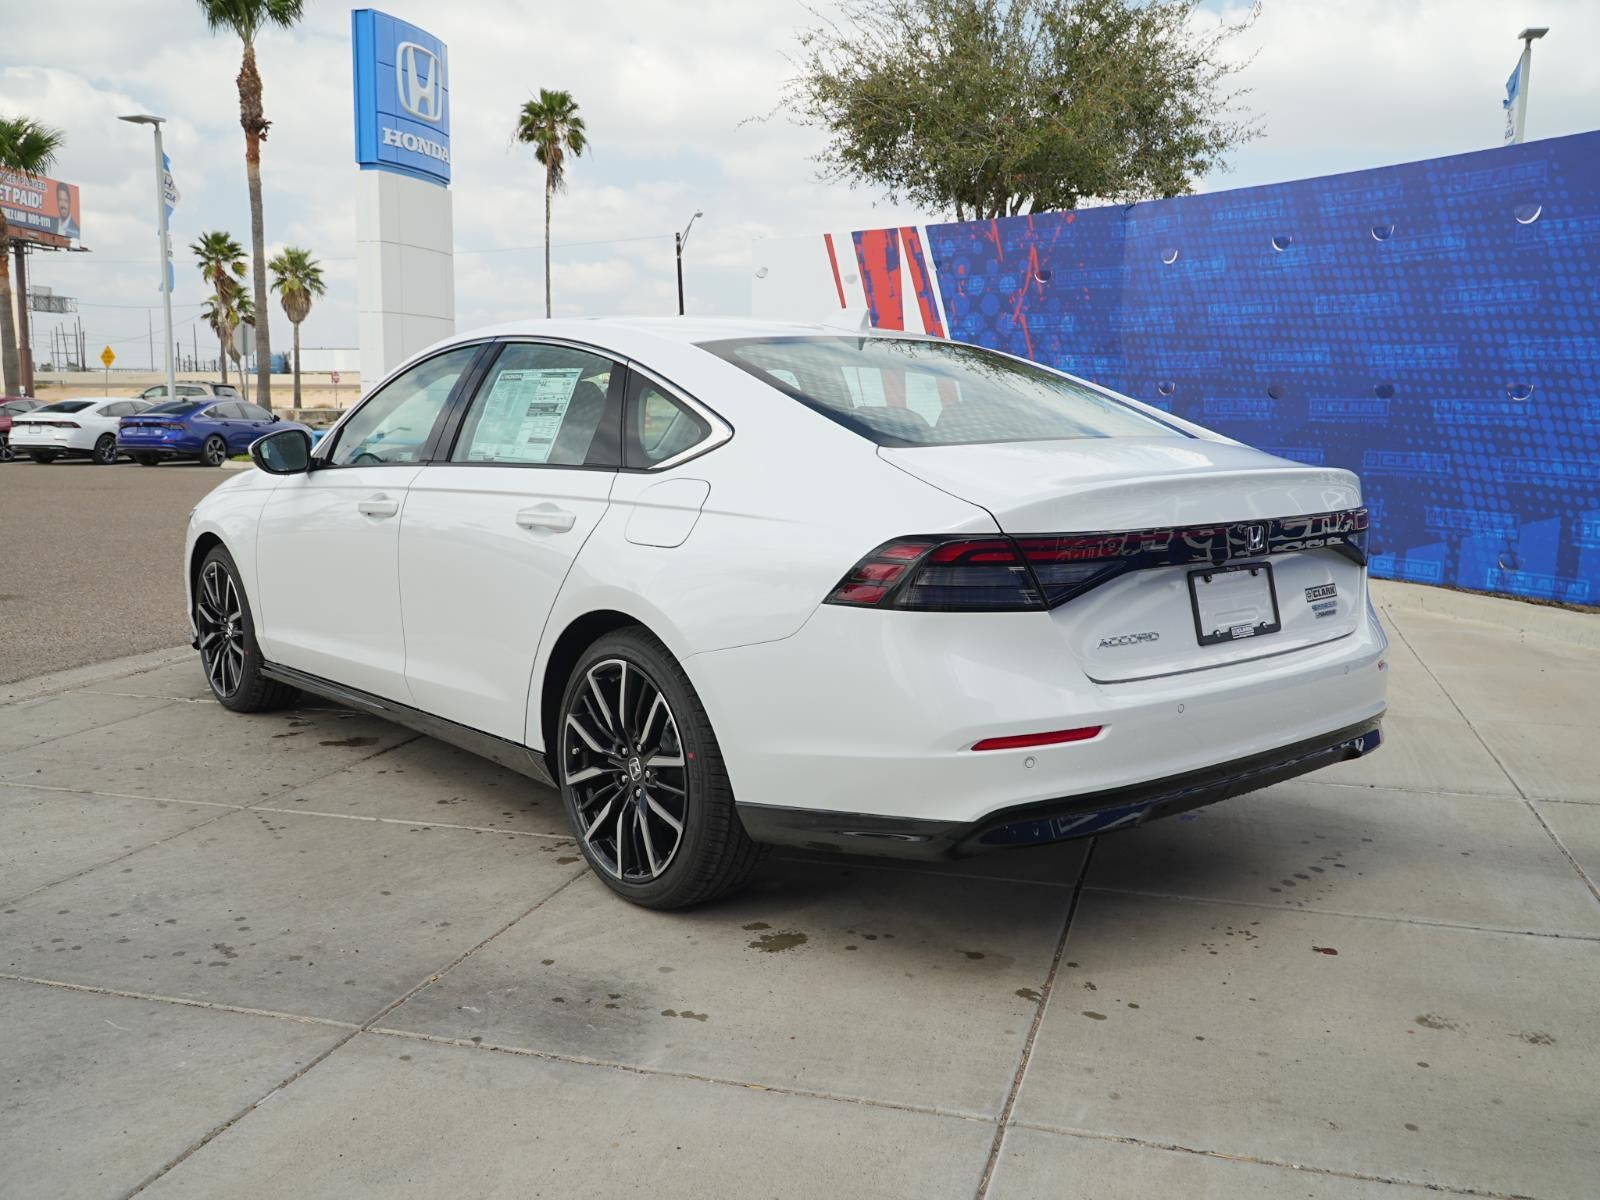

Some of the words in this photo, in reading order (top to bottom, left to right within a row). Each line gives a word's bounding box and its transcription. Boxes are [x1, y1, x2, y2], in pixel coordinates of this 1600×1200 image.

[382, 127, 450, 163] HONDA
[12, 187, 42, 209] PAID!
[1312, 586, 1336, 598] CLARK
[1096, 631, 1160, 650] ACCORD
